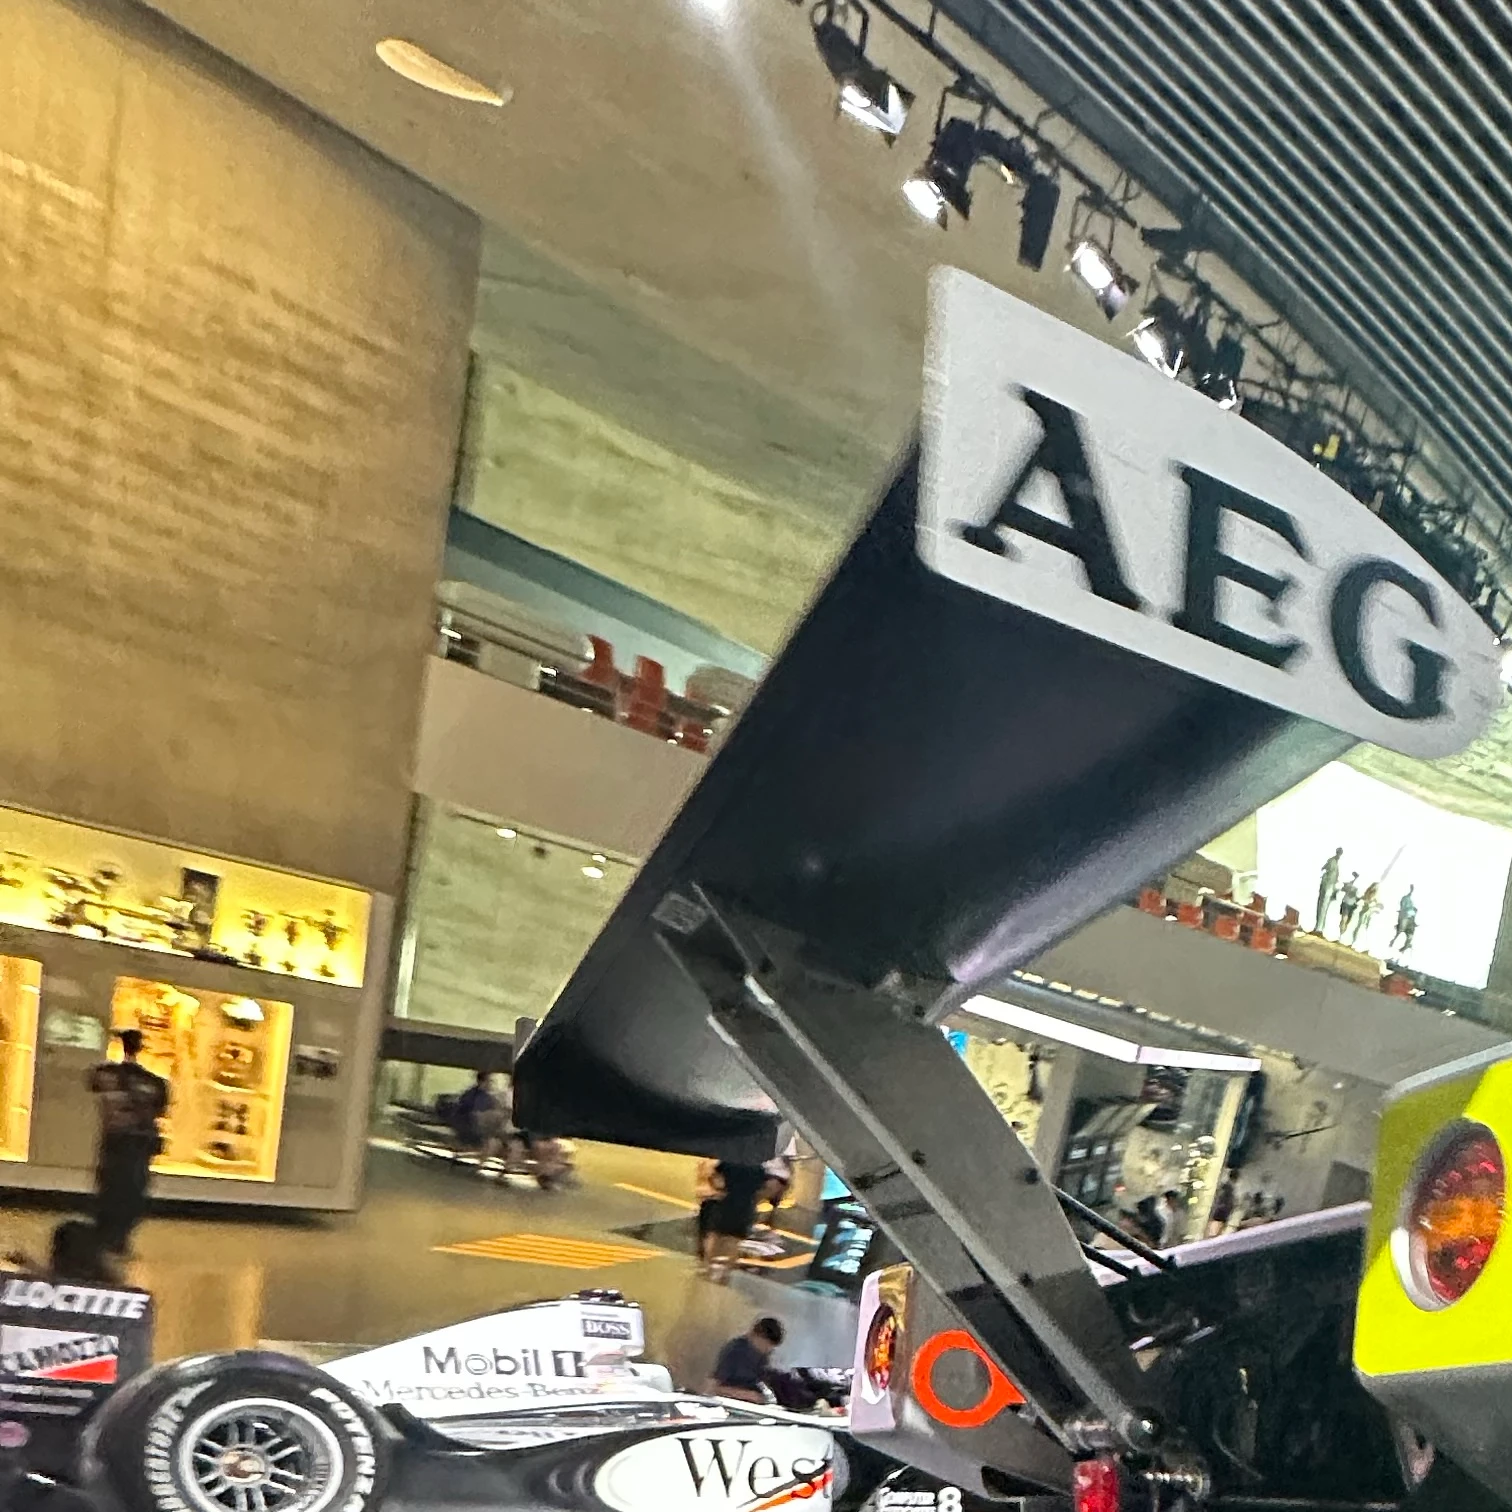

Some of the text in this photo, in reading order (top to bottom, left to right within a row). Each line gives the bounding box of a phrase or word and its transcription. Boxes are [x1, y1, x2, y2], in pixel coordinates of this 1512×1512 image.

[950, 382, 1456, 722] AEG
[3, 1279, 151, 1319] LOCTITE
[422, 1346, 542, 1376] Mobil
